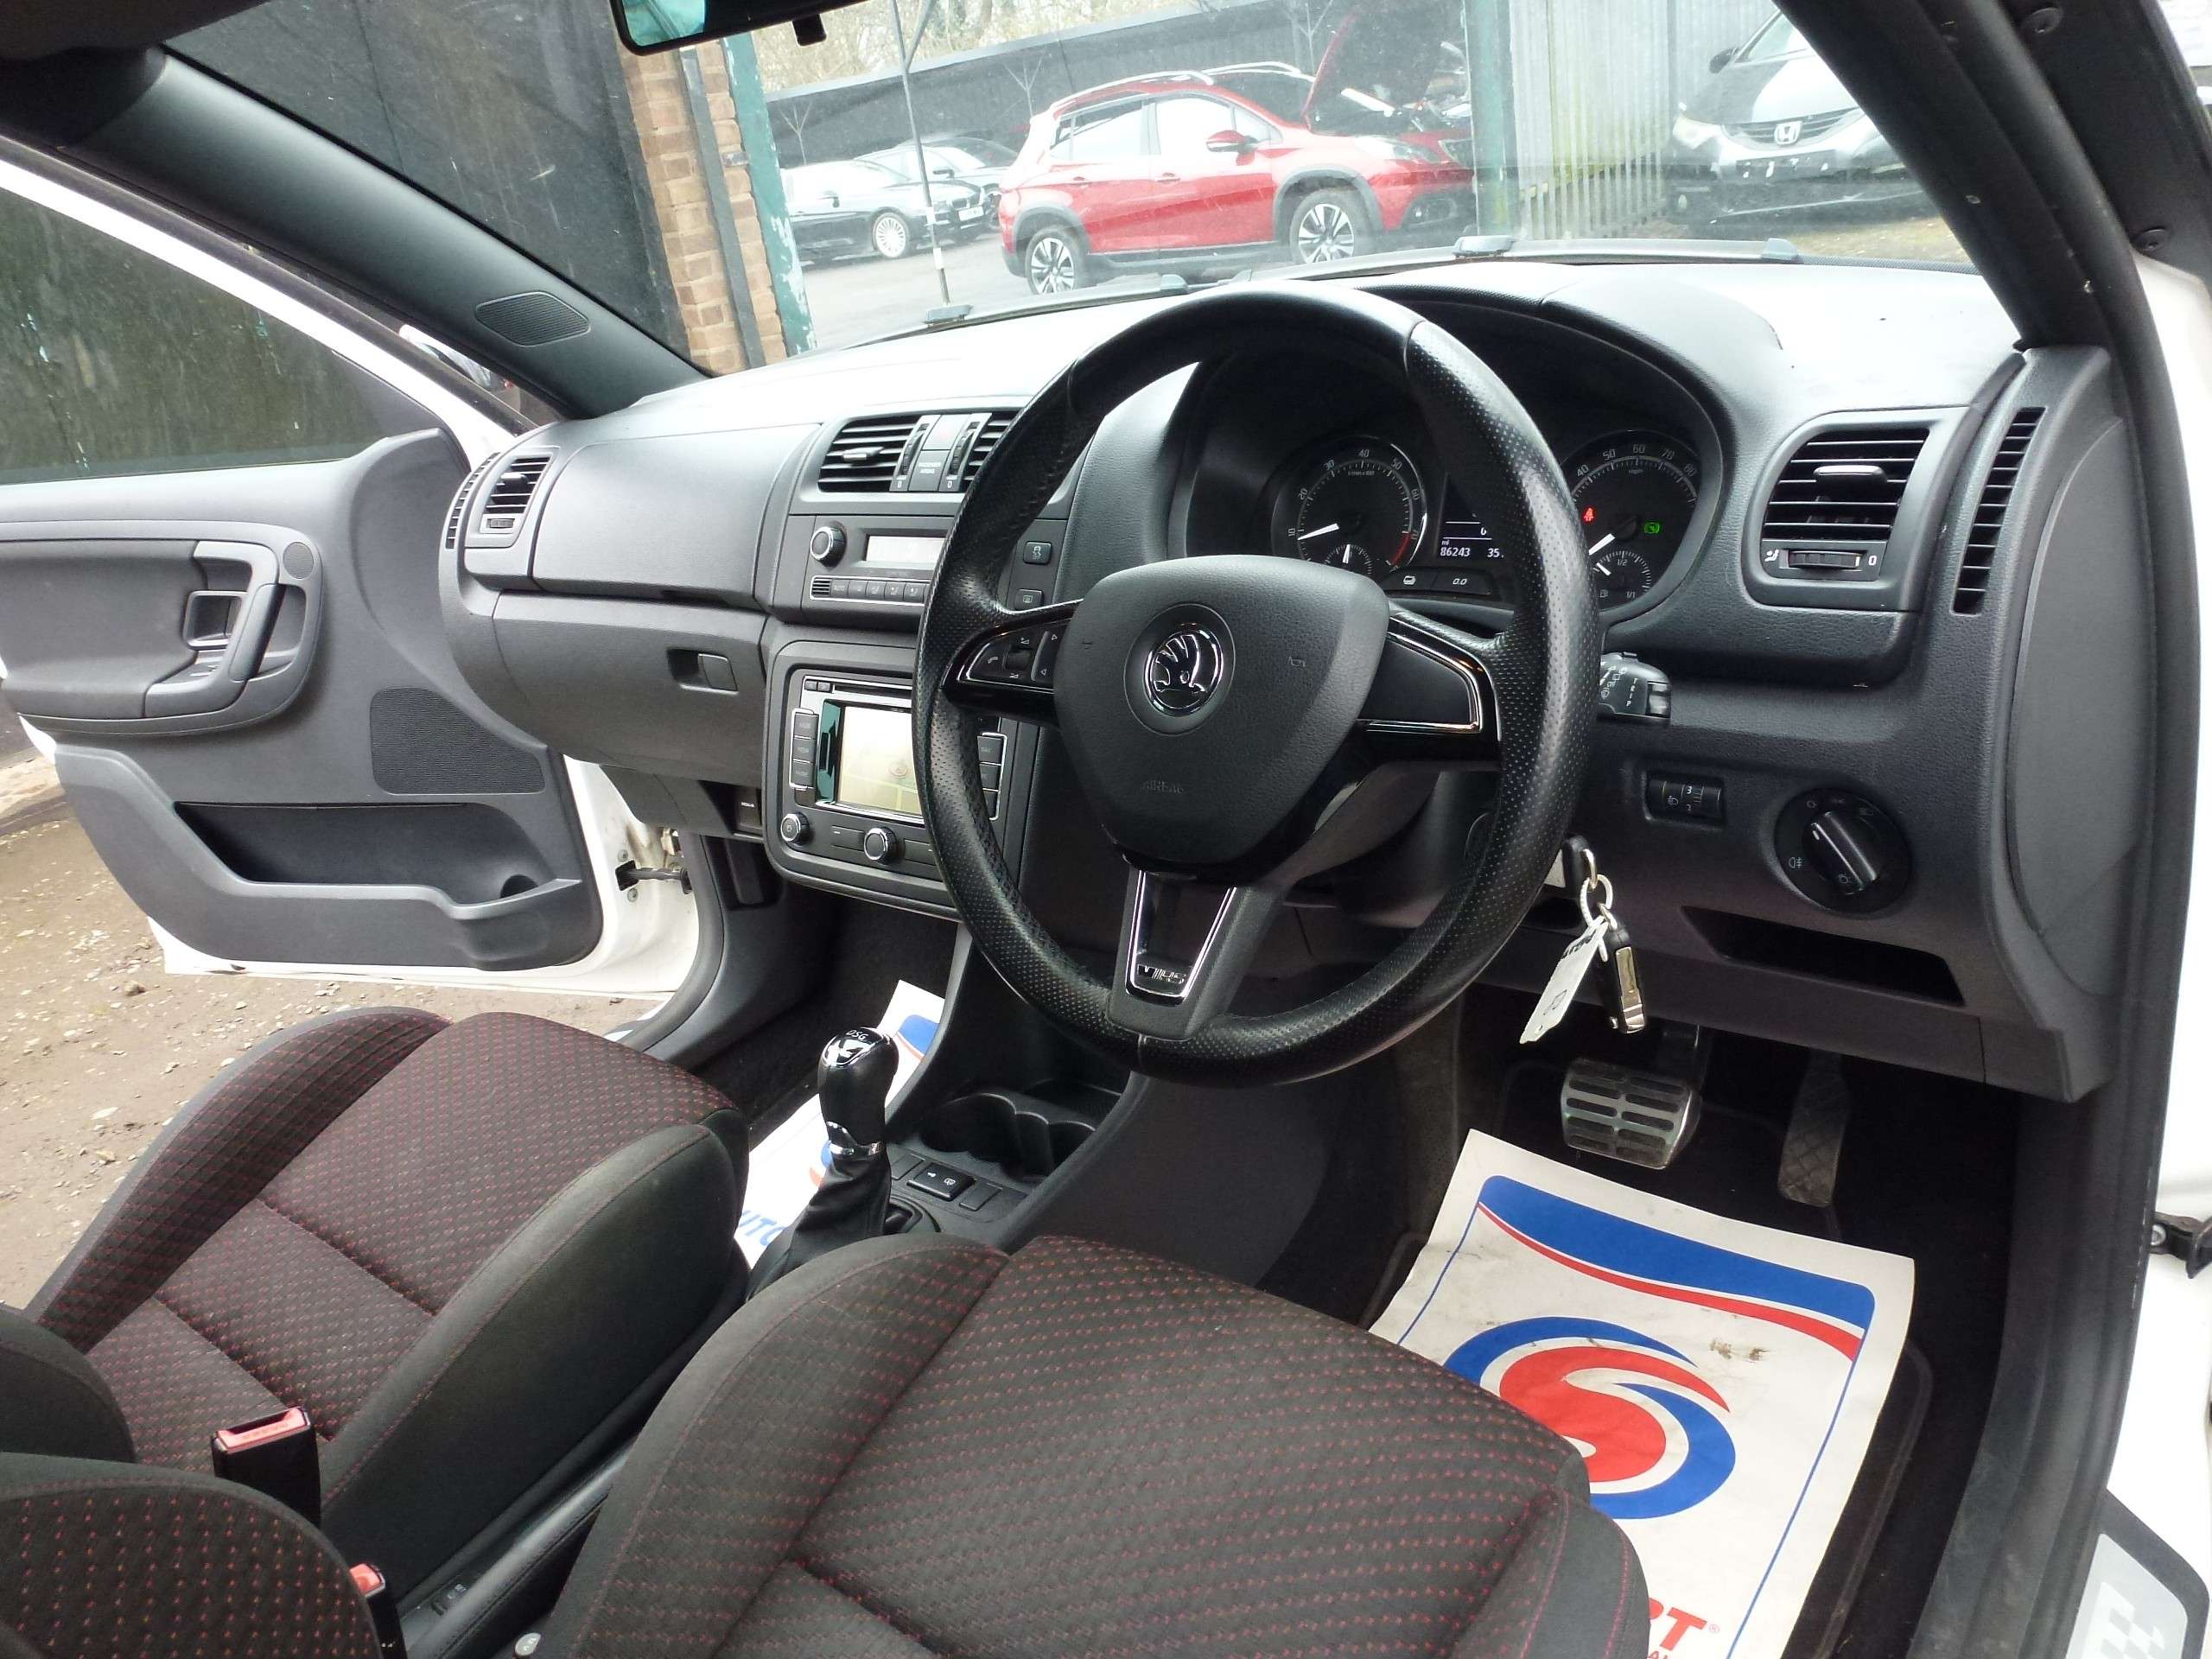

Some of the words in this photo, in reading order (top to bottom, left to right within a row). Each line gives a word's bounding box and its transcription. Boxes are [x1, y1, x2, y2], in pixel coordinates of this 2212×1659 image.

[1358, 448, 1370, 458] 40
[1602, 448, 1616, 460] 50
[1323, 459, 1335, 471] 30
[1298, 487, 1308, 500] 20
[1440, 547, 1471, 557] 86243
[1626, 677, 1638, 707] TRIP
[845, 1029, 869, 1041] DSG
